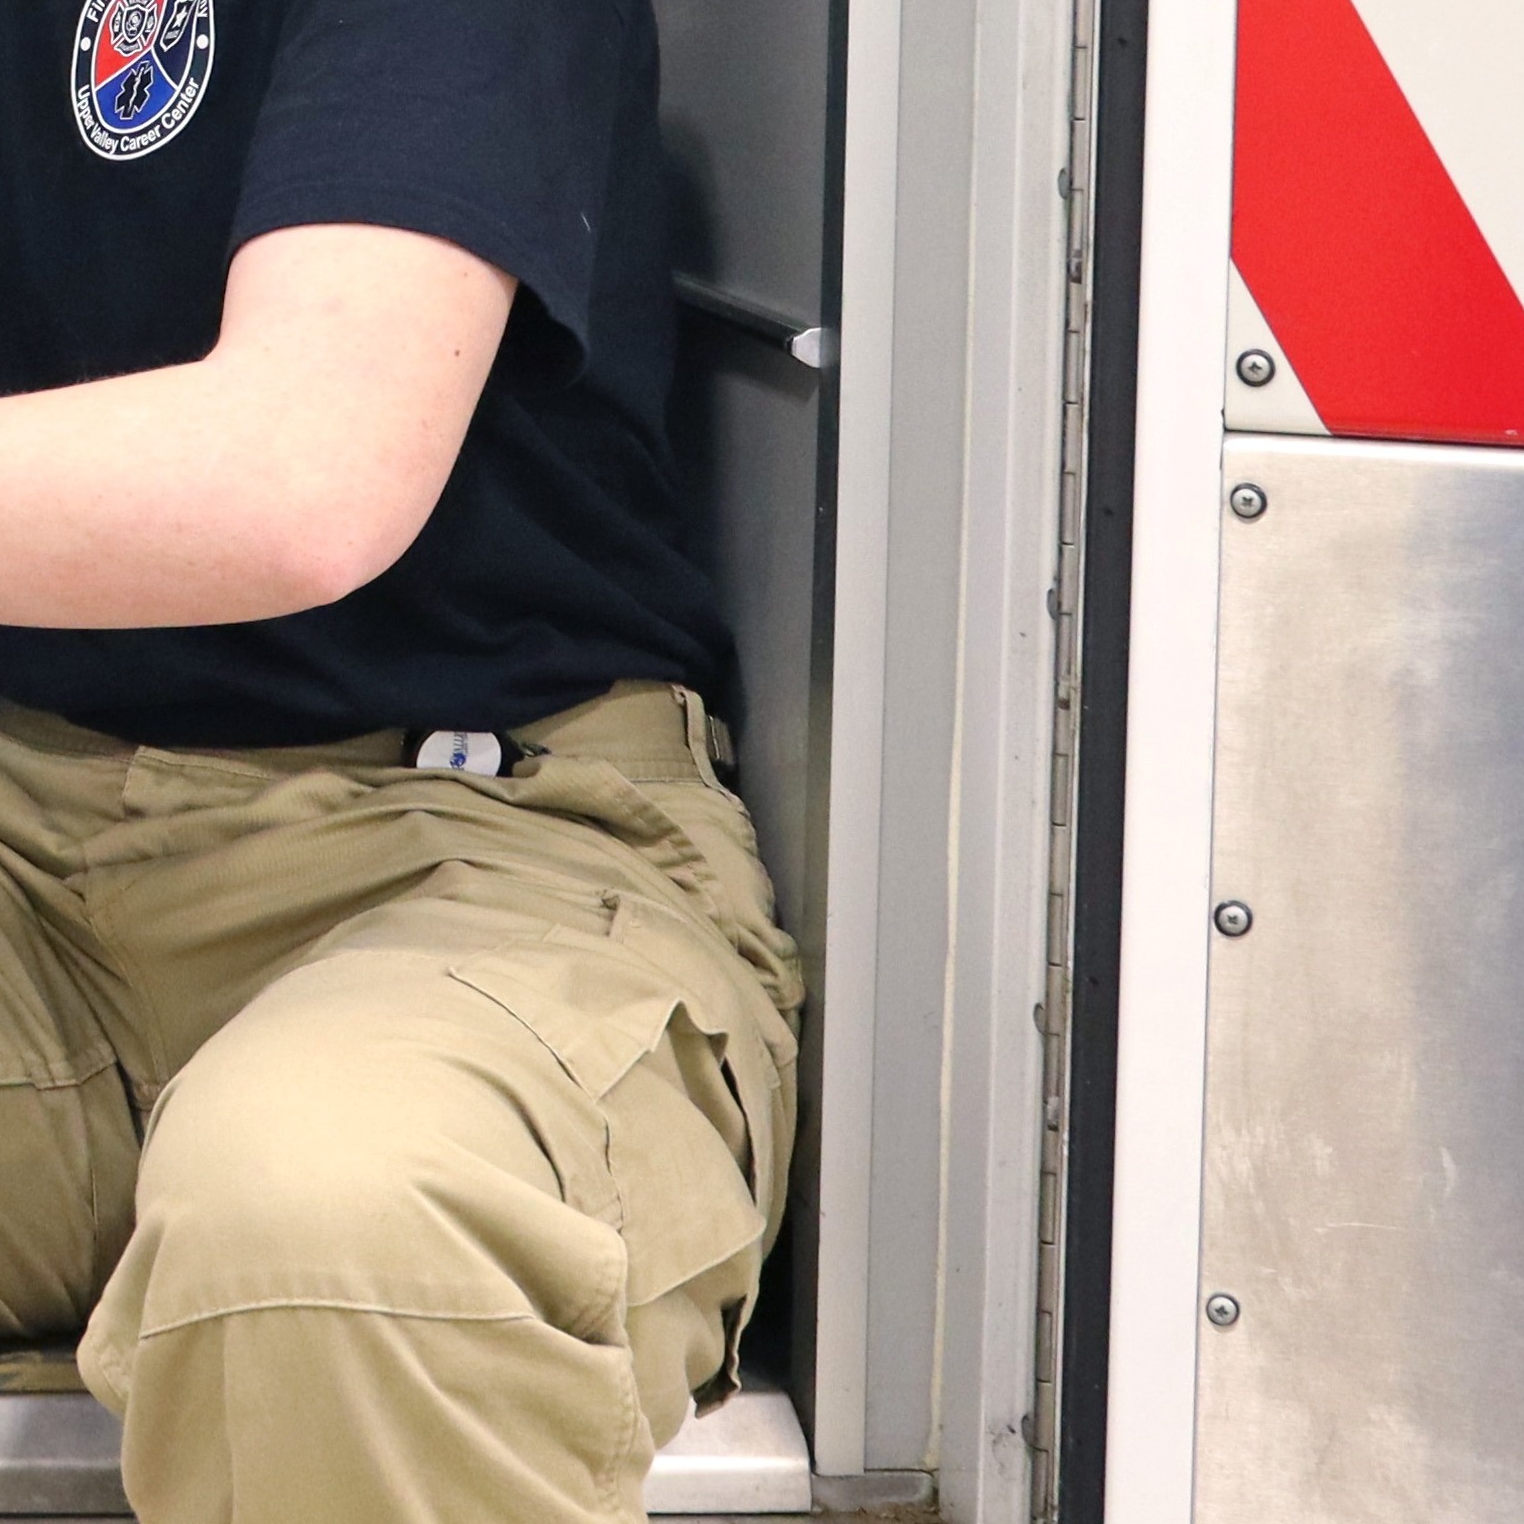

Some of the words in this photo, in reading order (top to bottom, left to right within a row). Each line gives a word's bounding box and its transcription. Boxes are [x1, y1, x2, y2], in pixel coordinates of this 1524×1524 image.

[77, 84, 95, 130] Upper
[90, 123, 119, 155] Valley
[120, 124, 161, 152] Career
[161, 77, 200, 129] Center
